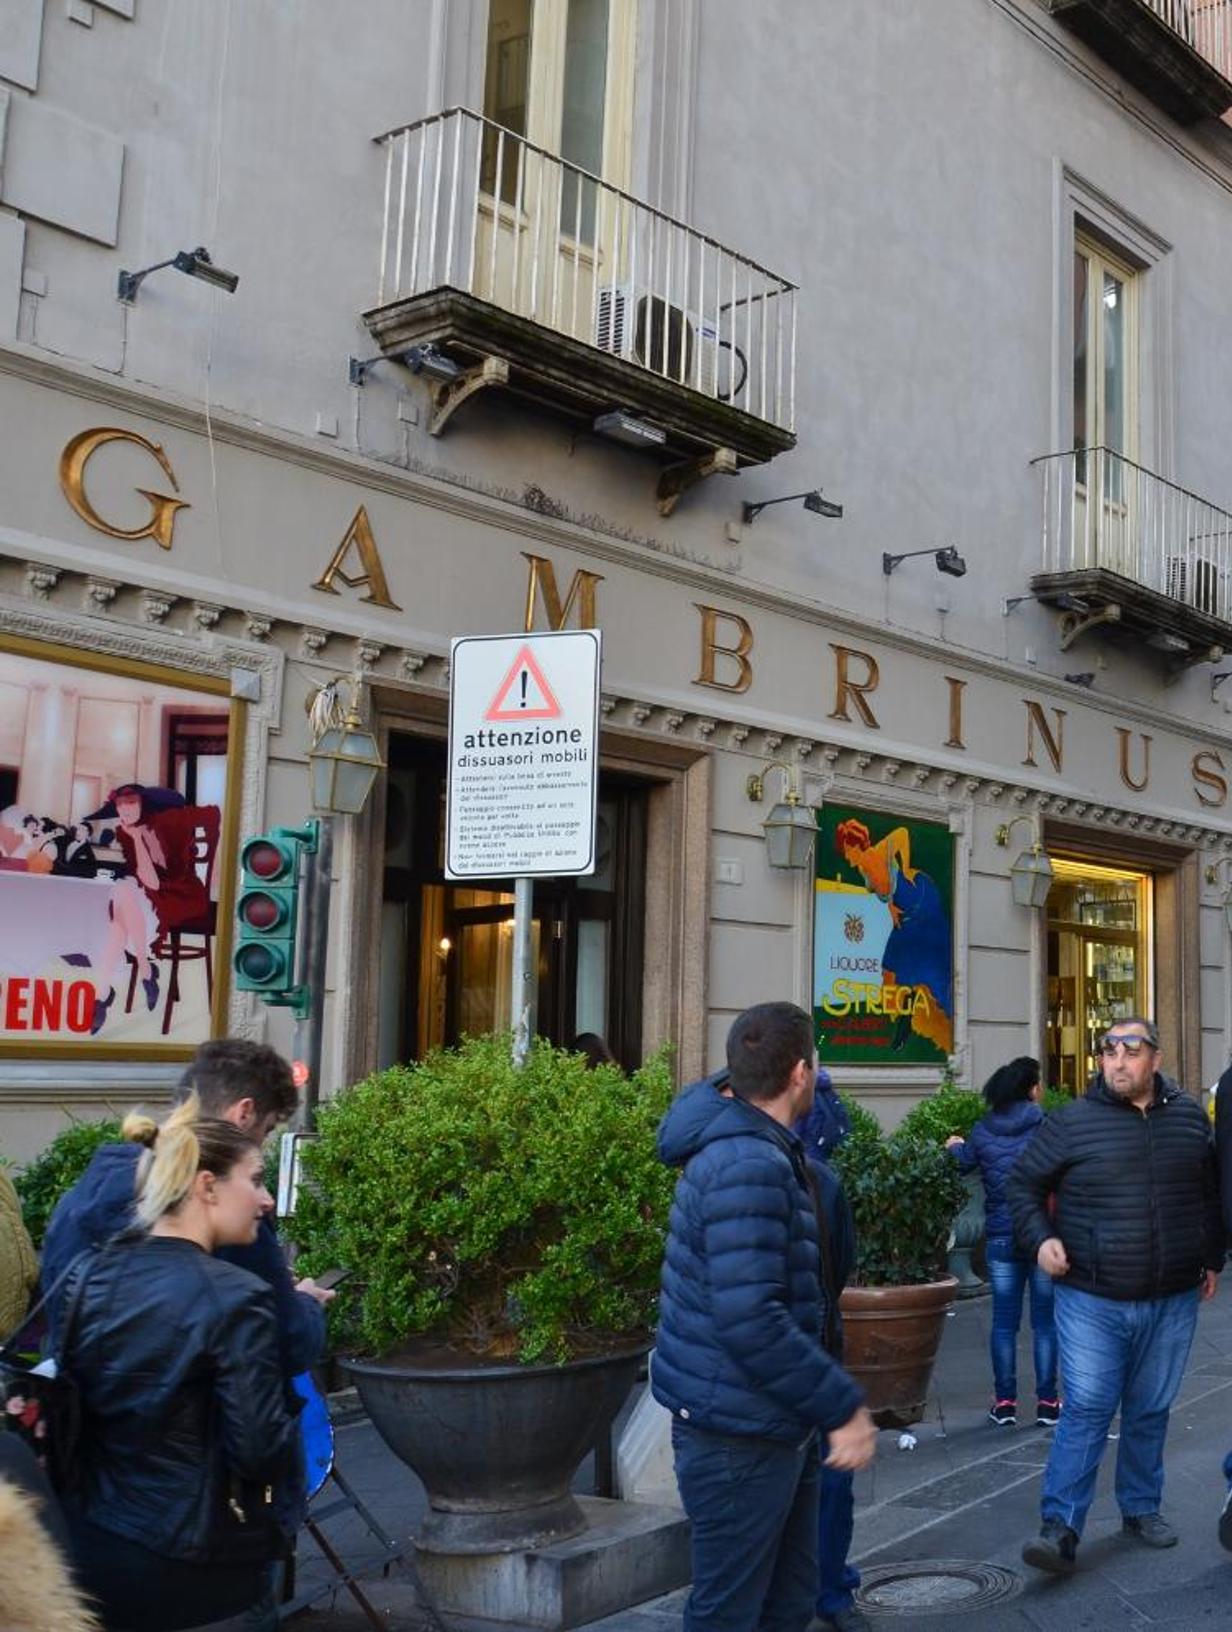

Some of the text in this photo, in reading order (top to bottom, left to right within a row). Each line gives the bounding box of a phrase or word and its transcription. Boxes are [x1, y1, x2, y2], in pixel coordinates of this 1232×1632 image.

[59, 426, 1229, 806] GAMBRINUS
[457, 748, 587, 768] dissuasori mobili
[463, 726, 582, 749] attenzione
[0, 976, 97, 1034] ENO
[823, 978, 930, 1019] STREGA
